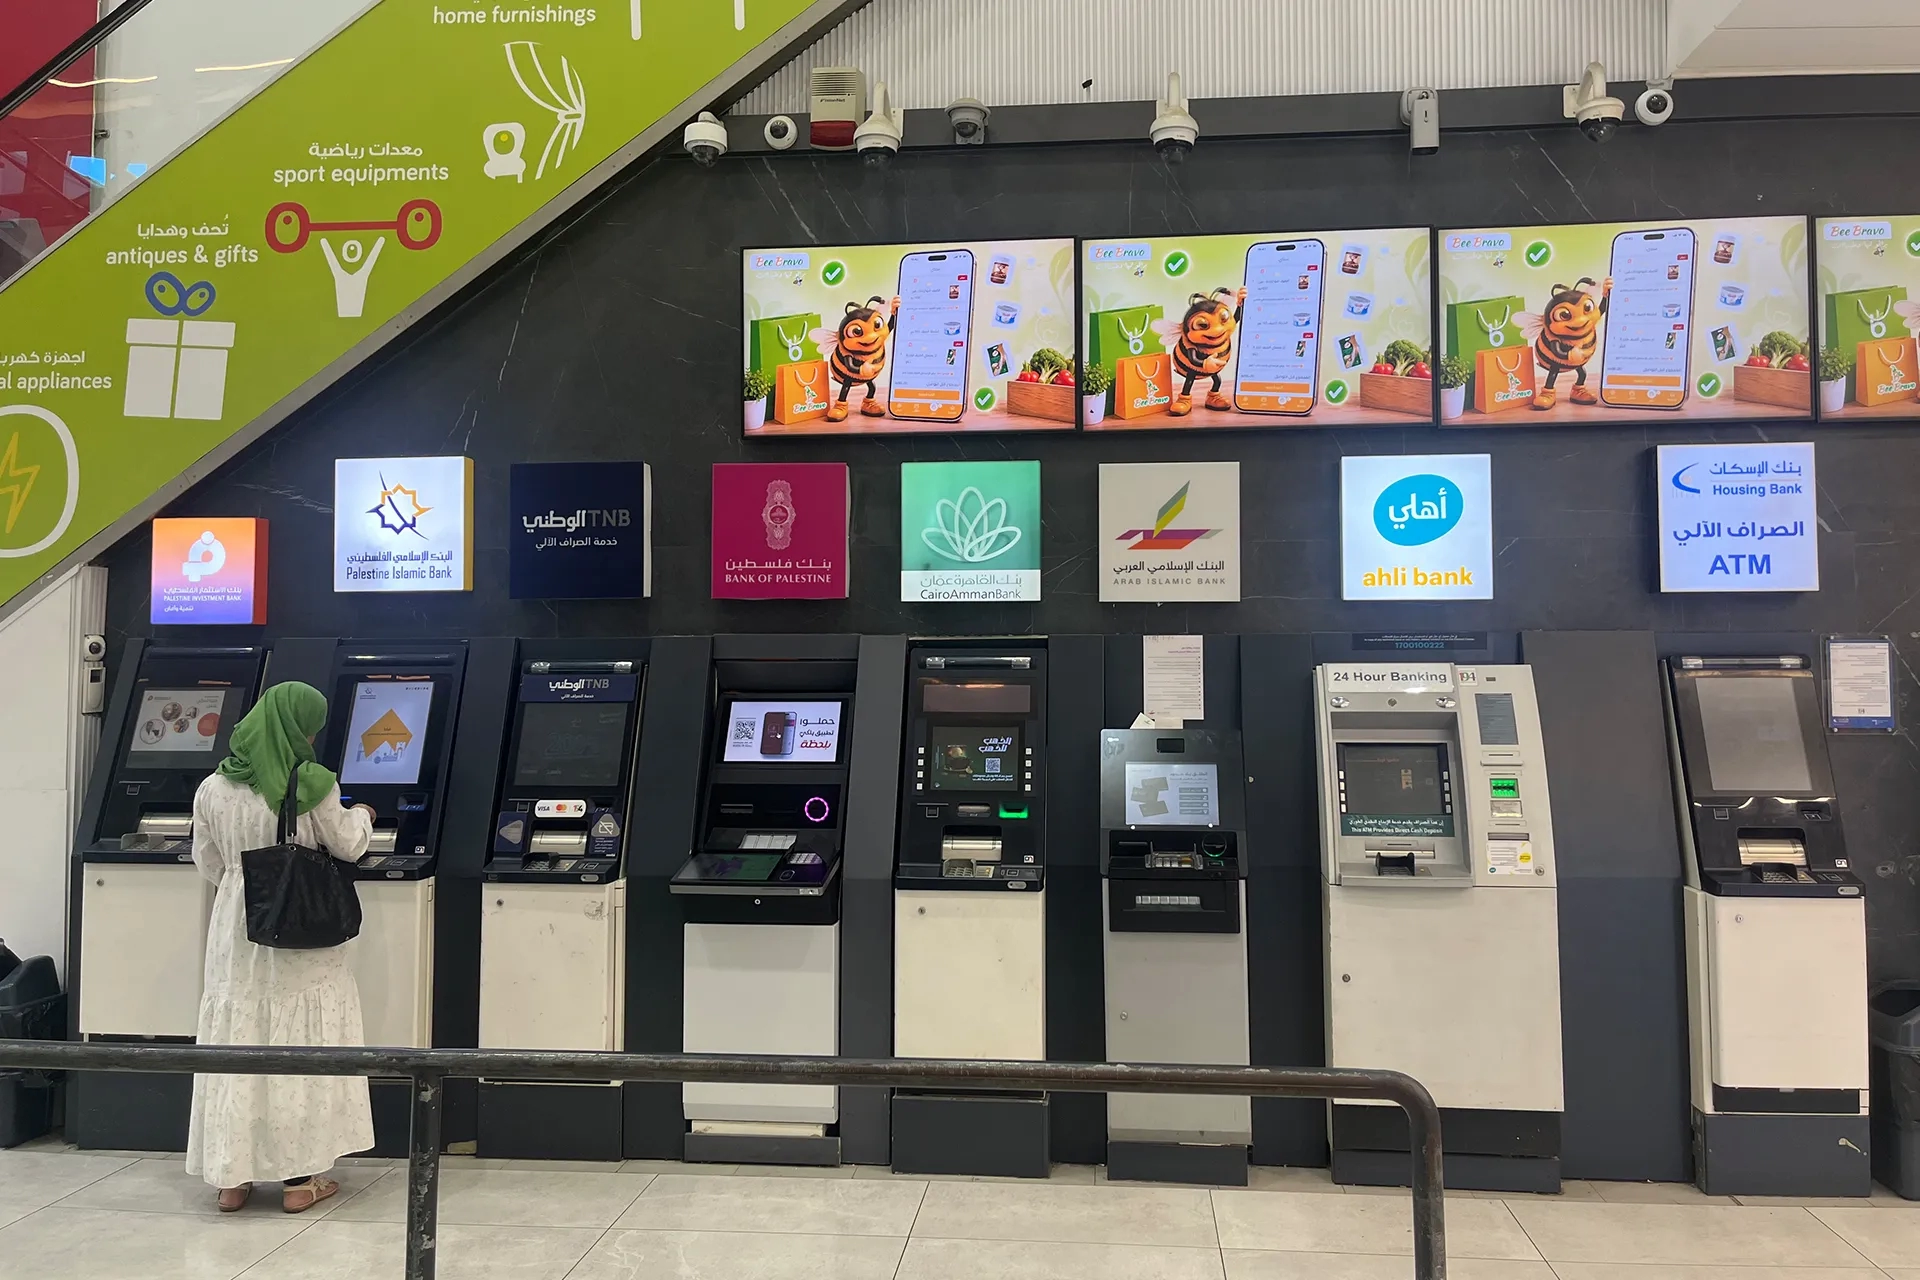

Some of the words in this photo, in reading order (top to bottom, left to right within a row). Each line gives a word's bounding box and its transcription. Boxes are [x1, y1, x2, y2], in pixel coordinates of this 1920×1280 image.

[433, 6, 486, 24] home
[492, 4, 596, 26] furnishings
[308, 142, 364, 160] رياضية
[369, 142, 423, 157] معدات
[273, 166, 325, 187] sport
[331, 164, 449, 186] equipments
[137, 223, 188, 240] وهدايا
[1831, 225, 1850, 237] Bee
[1852, 224, 1885, 237] Bravo
[1452, 237, 1471, 249] Bee
[1473, 236, 1504, 248] Bravo
[106, 247, 188, 268] antiques
[193, 244, 208, 263] &
[214, 244, 258, 268] gifts
[1115, 246, 1145, 258] Bravo
[17, 370, 112, 394] appliances
[1771, 460, 1802, 477] بنك
[1713, 484, 1766, 497] Housing
[1769, 483, 1802, 495] Bank
[1388, 487, 1447, 530] أهلي
[522, 510, 586, 533] الوطني
[587, 509, 631, 527] TNB
[1727, 521, 1804, 540] الصراف
[559, 537, 591, 548] الصراف
[594, 537, 618, 546] خدمة
[430, 550, 453, 562] البنك
[725, 558, 792, 571] فلسطين
[796, 558, 832, 571] بنك
[1113, 561, 1145, 574] العربي
[1196, 560, 1225, 573] البنك
[1708, 554, 1771, 575] ATM
[346, 566, 389, 580] Palestine
[392, 566, 426, 579] Islamic
[429, 565, 453, 579] Bank
[725, 574, 755, 583] BANK
[758, 574, 773, 583] OF
[776, 574, 831, 583] PALESTINE
[1362, 566, 1407, 587] ahli
[1413, 566, 1473, 586] bank
[586, 679, 610, 688] TNB
[1333, 672, 1349, 681] 24
[1353, 672, 1386, 681] Hour
[1390, 672, 1447, 683] Banking
[549, 679, 585, 691] الوطني
